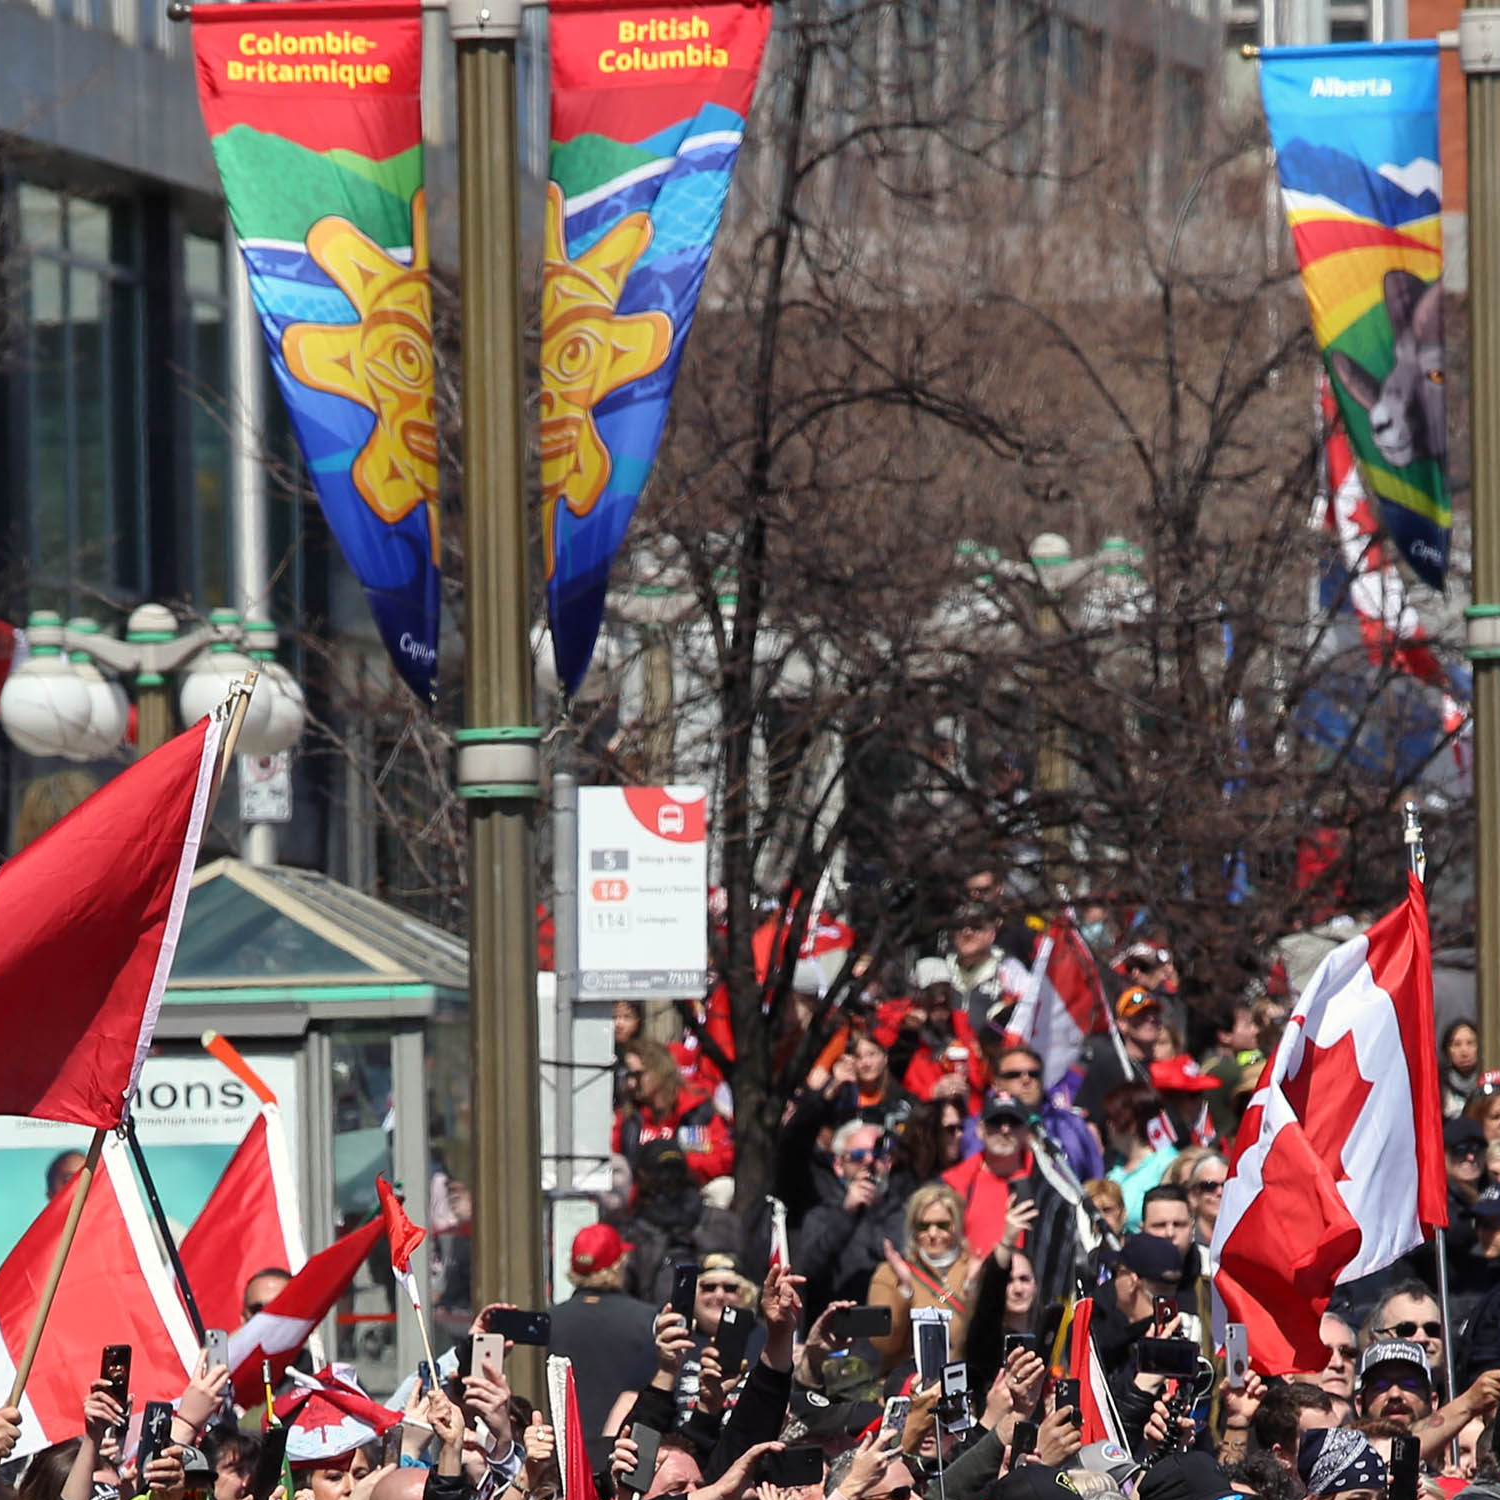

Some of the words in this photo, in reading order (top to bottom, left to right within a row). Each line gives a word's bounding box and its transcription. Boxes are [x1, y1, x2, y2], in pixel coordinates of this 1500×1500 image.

[238, 32, 377, 56] Colombie-
[617, 15, 709, 44] British
[598, 45, 729, 74] Columbia
[227, 60, 391, 89] Britannique
[1310, 76, 1392, 98] Alberta
[136, 1081, 245, 1110] ons
